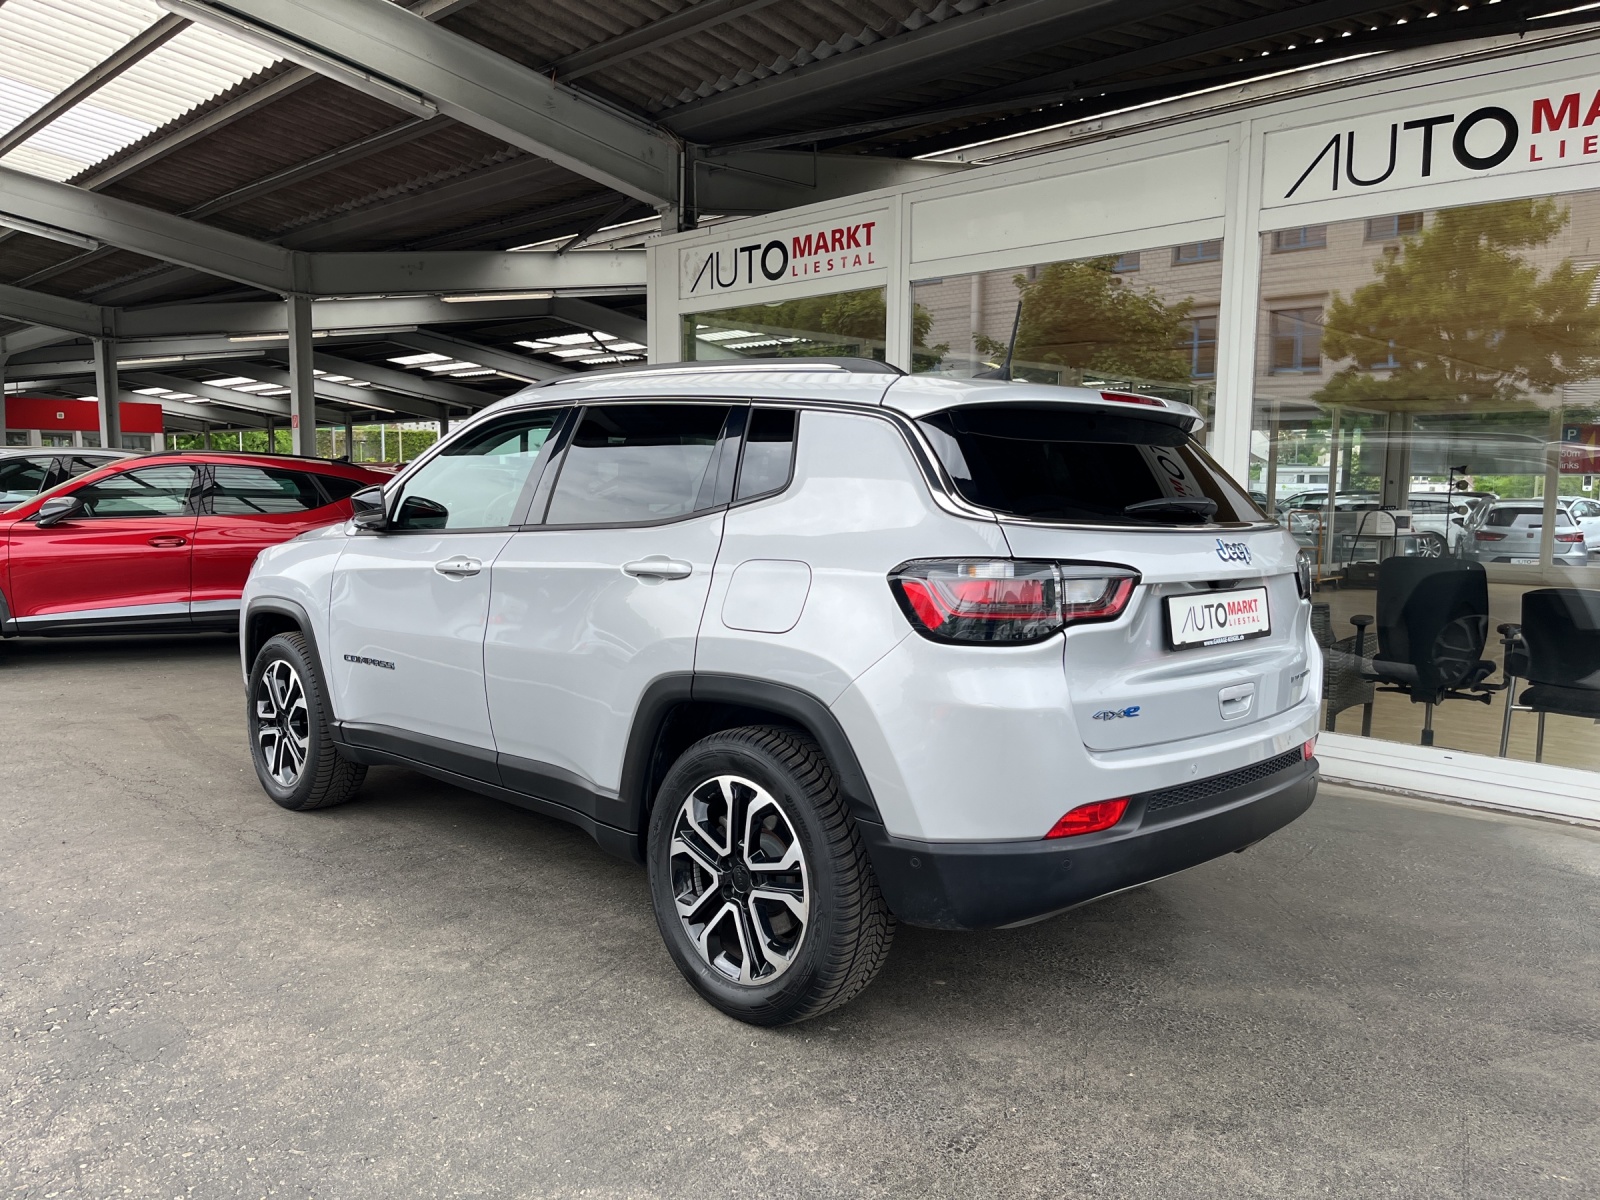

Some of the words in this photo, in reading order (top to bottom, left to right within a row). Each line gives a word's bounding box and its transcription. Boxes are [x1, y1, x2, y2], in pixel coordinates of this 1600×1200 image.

[1284, 106, 1519, 199] AUTO
[1529, 135, 1598, 162] LIE
[690, 240, 789, 293] AUTO
[792, 222, 876, 259] MARKT
[792, 252, 875, 277] LIESTAL
[1567, 429, 1577, 440] P
[1215, 538, 1252, 566] Jeep
[1182, 603, 1228, 633] AUTO
[1227, 599, 1258, 616] MARKT
[1229, 616, 1260, 627] LIESTAL
[343, 654, 396, 670] COMPASS
